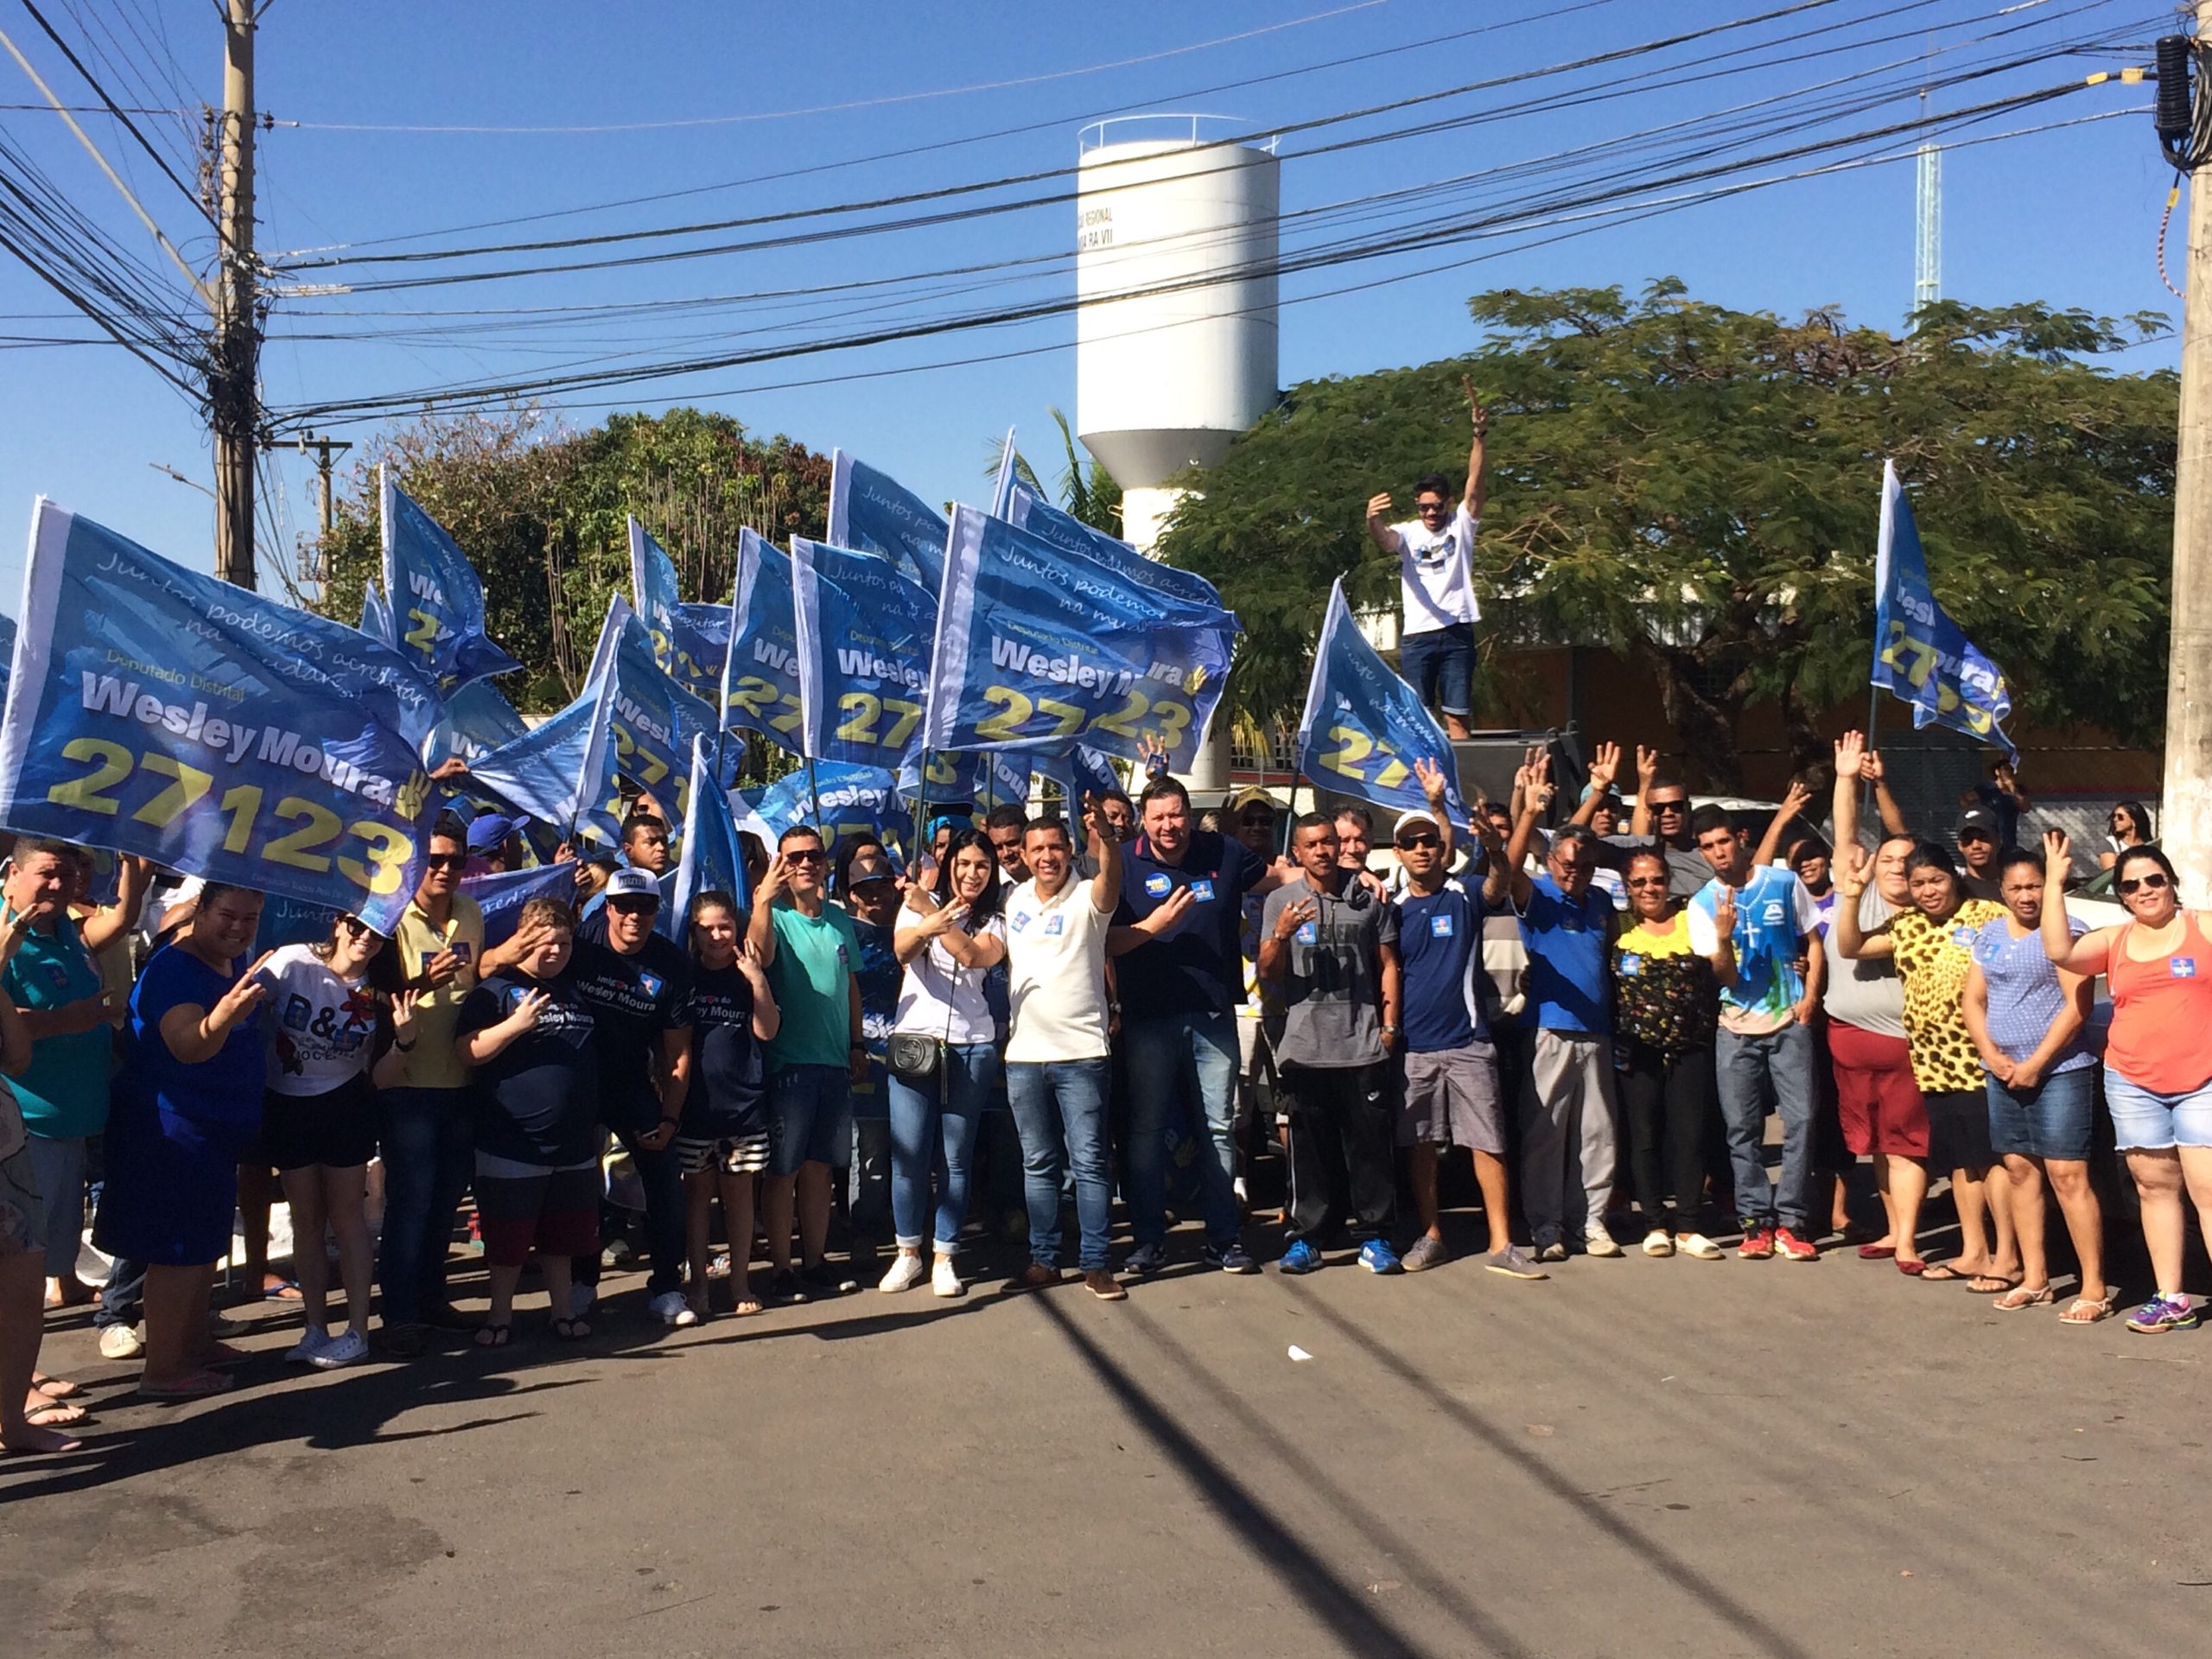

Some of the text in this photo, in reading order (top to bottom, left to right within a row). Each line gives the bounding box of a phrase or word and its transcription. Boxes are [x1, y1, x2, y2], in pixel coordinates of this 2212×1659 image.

[862, 486, 912, 520] Juntos
[830, 565, 887, 590] Juntos
[1001, 546, 1069, 586] Juntos
[1058, 598, 1086, 616] na
[184, 618, 225, 643] na
[206, 603, 325, 661] podemos
[107, 649, 245, 702] Deputado Distrital
[837, 648, 931, 695] Wesley
[991, 635, 1114, 699] Wesley
[82, 671, 392, 805] Wesley Moura
[47, 737, 414, 895] 27123
[276, 900, 338, 925] Junto
[576, 979, 617, 1001] Wesley
[617, 992, 656, 1012] Moura
[538, 1012, 565, 1024] esley
[710, 1006, 746, 1020] Moura
